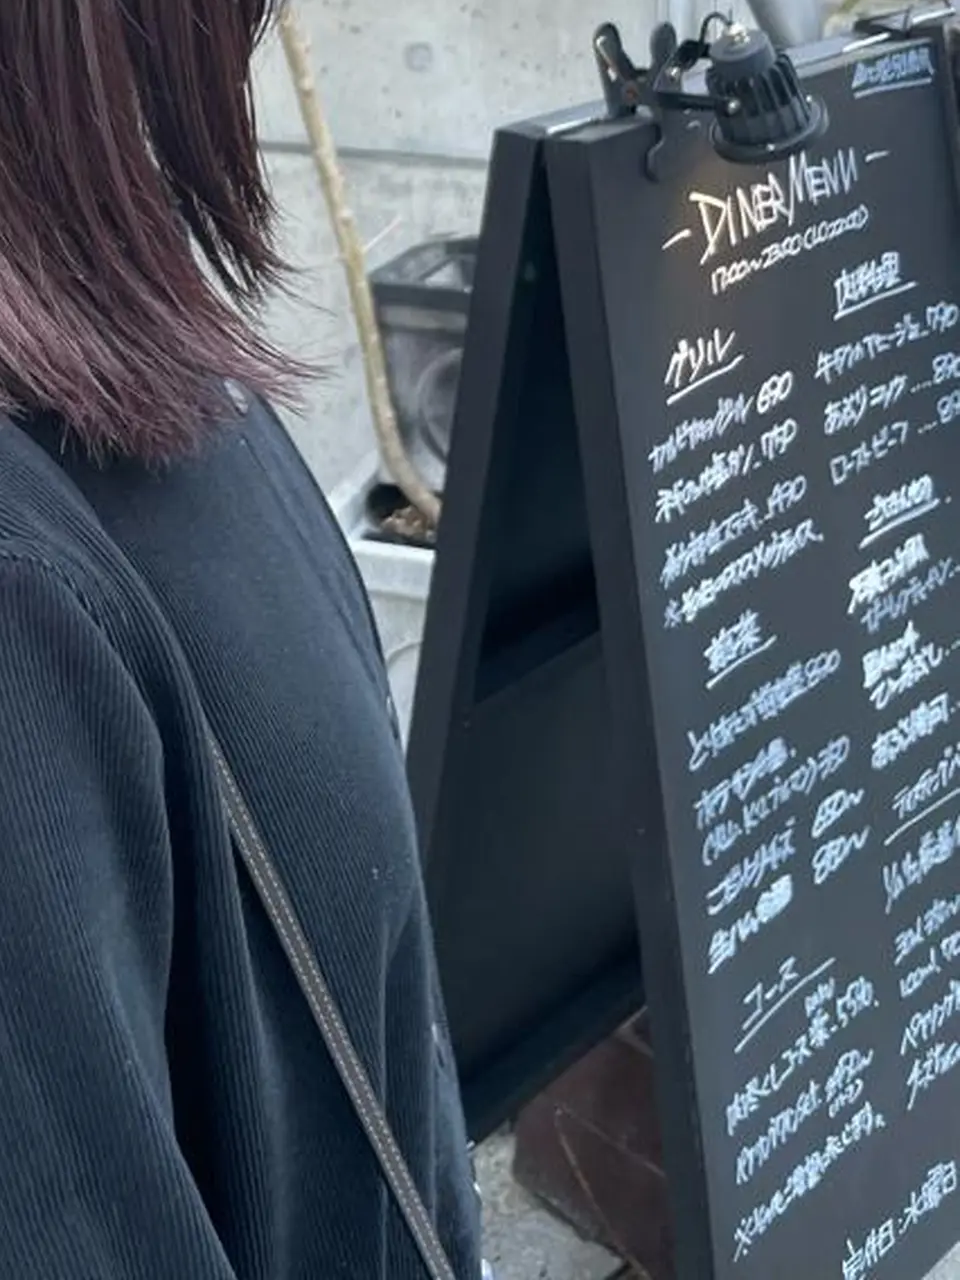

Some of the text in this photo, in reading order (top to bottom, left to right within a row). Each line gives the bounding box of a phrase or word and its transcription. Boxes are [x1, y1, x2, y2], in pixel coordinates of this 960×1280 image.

[664, 327, 736, 389] グリル
[742, 955, 801, 1033] コース
